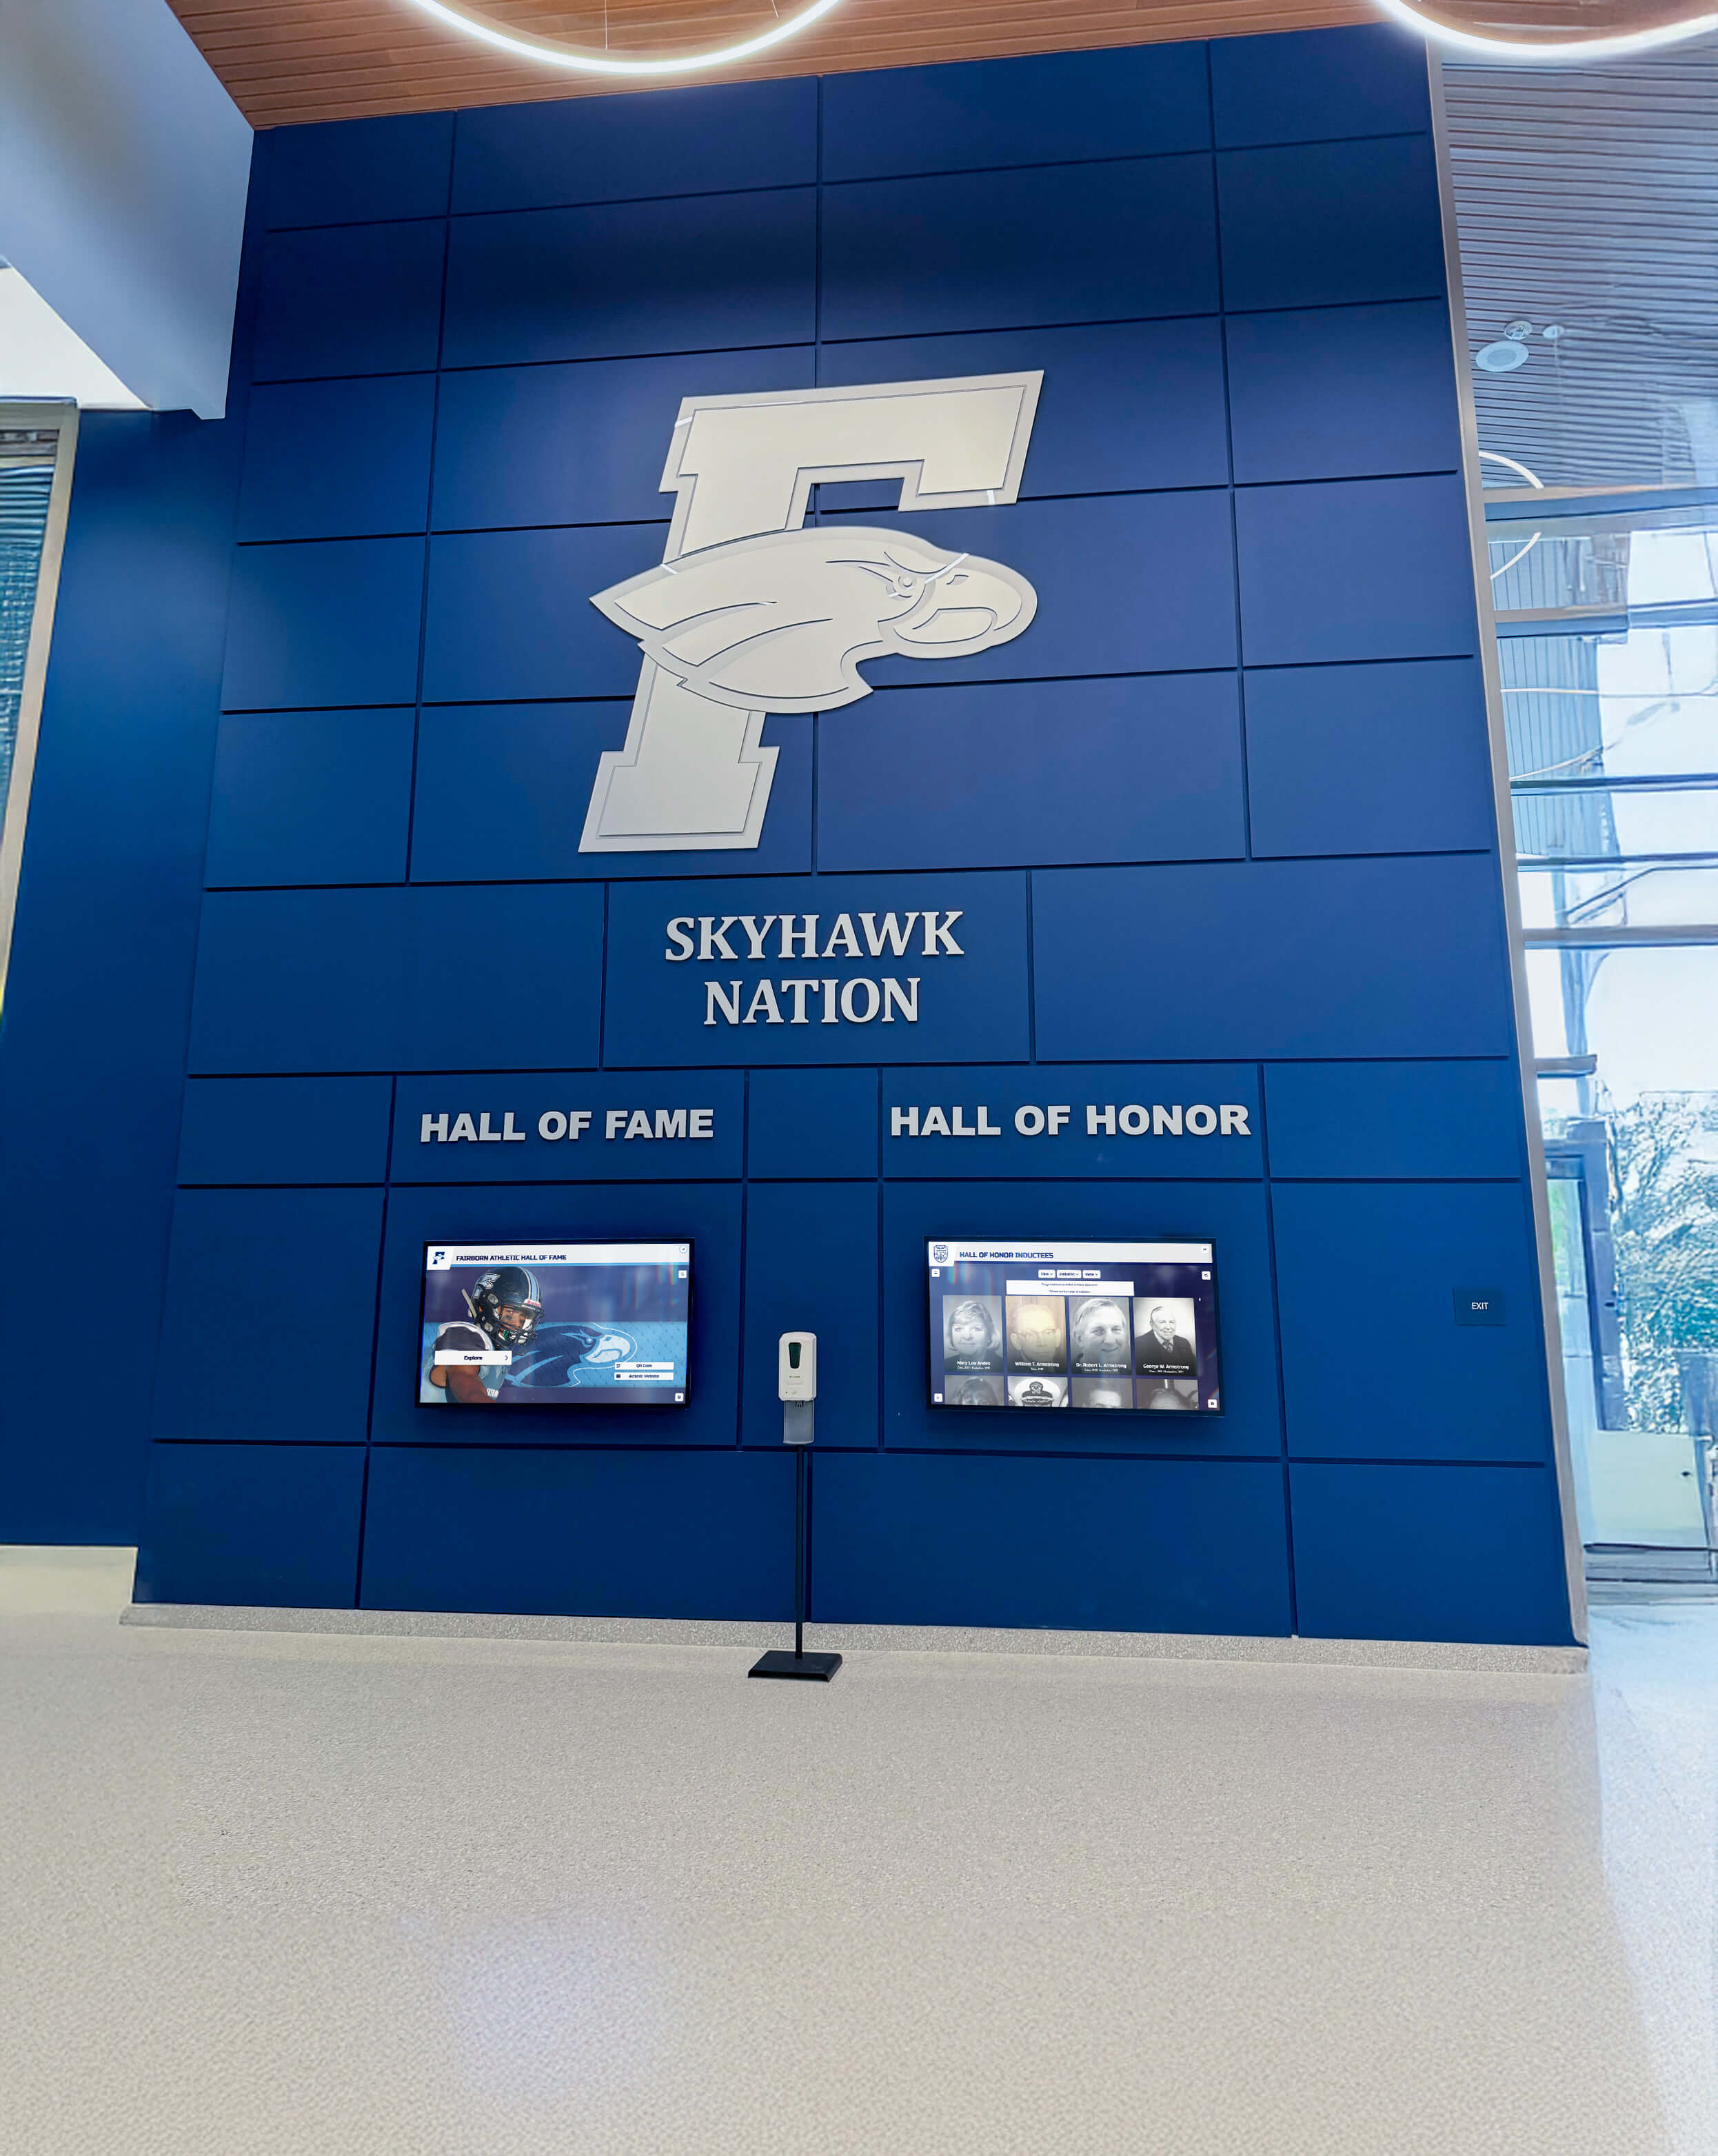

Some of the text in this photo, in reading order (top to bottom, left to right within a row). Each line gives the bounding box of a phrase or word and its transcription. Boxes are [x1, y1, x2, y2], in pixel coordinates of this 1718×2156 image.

[665, 911, 965, 961] SKYHAWK
[703, 977, 921, 1026] NATION
[420, 1109, 714, 1142] HALL OF FAME
[890, 1105, 1252, 1136] HALL OF HONOR
[1471, 1302, 1489, 1310] EXIT
